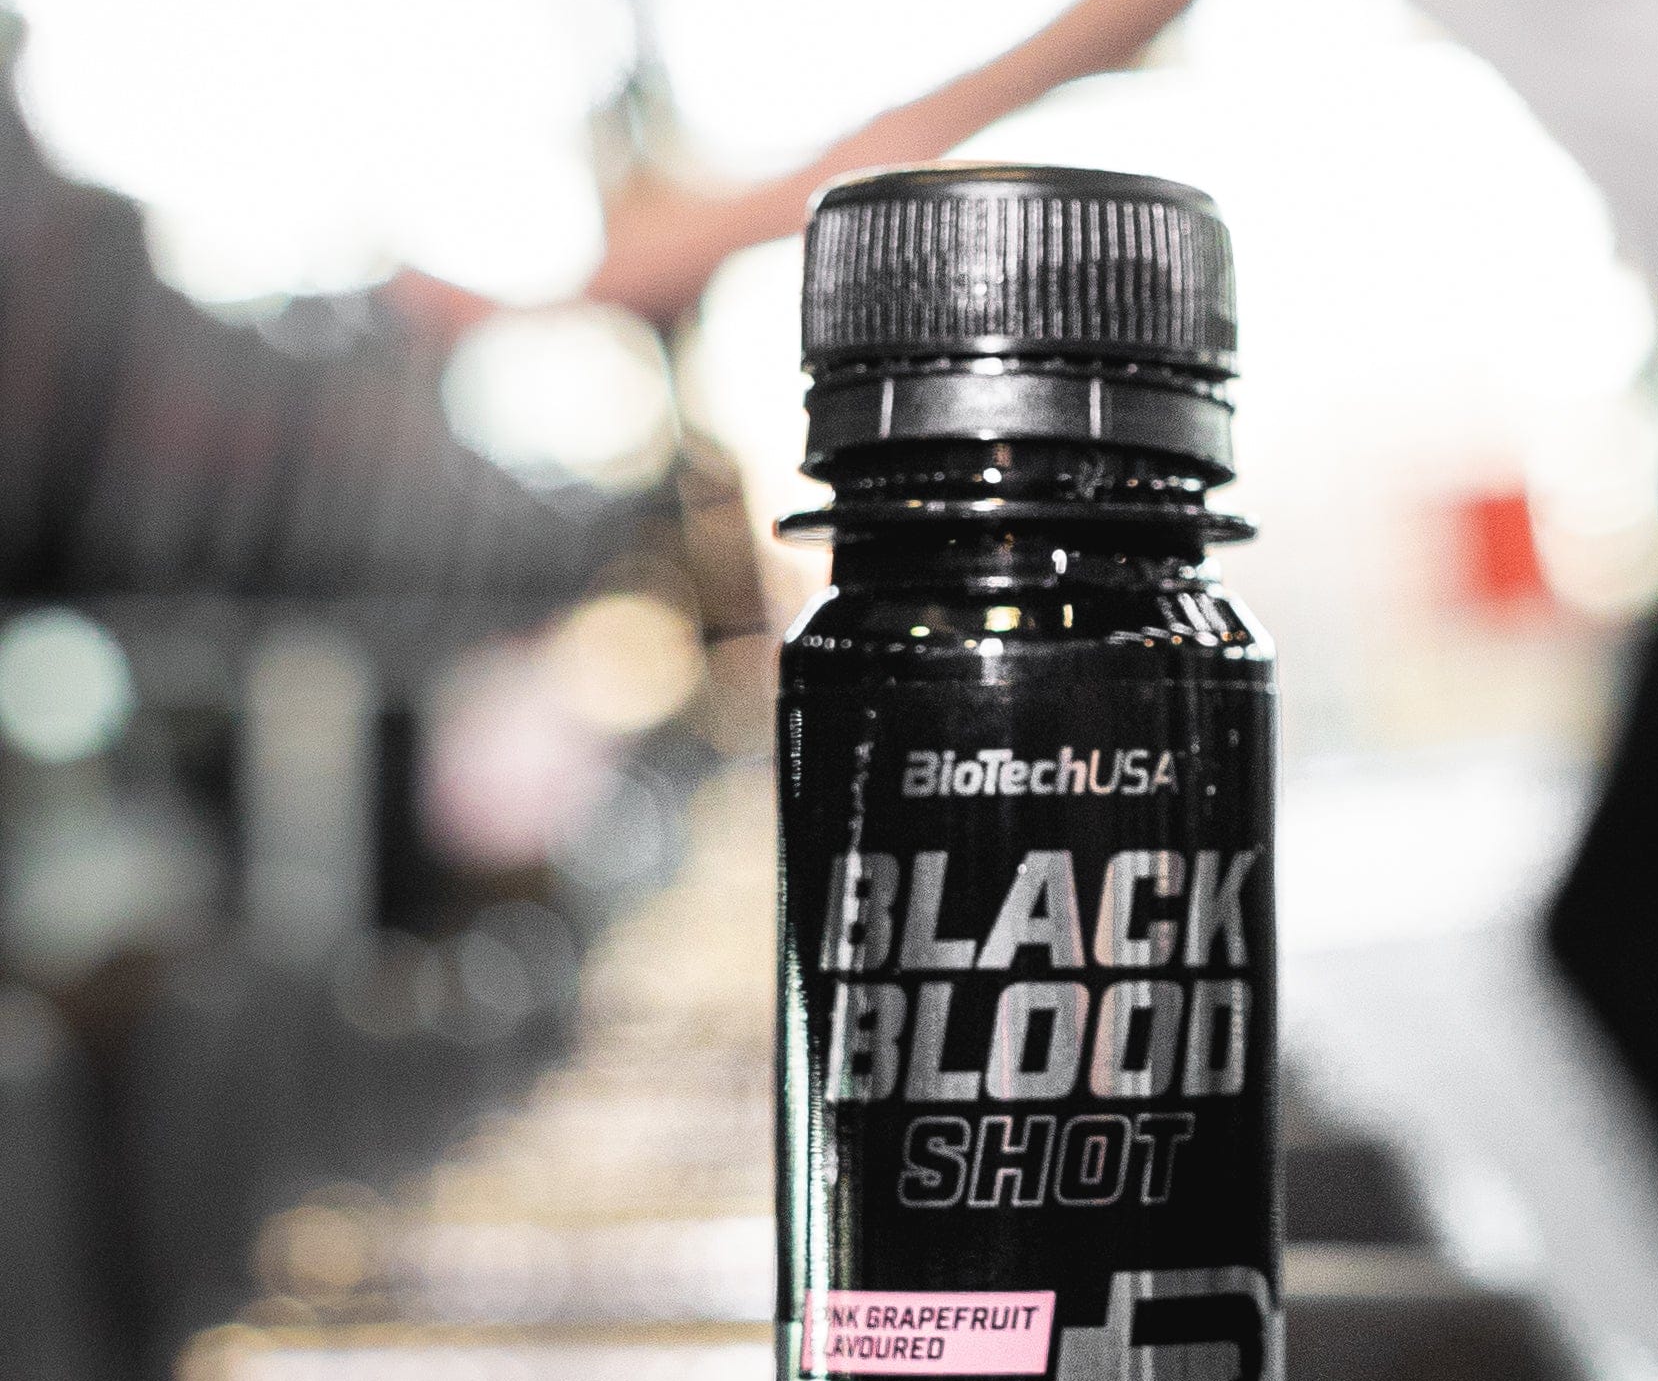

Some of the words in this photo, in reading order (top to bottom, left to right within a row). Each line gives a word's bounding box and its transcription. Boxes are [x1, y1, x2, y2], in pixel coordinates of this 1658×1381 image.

[819, 851, 1257, 970] BLACK
[826, 980, 1252, 1101] BLOOD
[899, 1113, 1194, 1208] SHOT
[811, 1335, 945, 1360] LAVOURED
[866, 1305, 1039, 1331] GRAPEFRUIT
